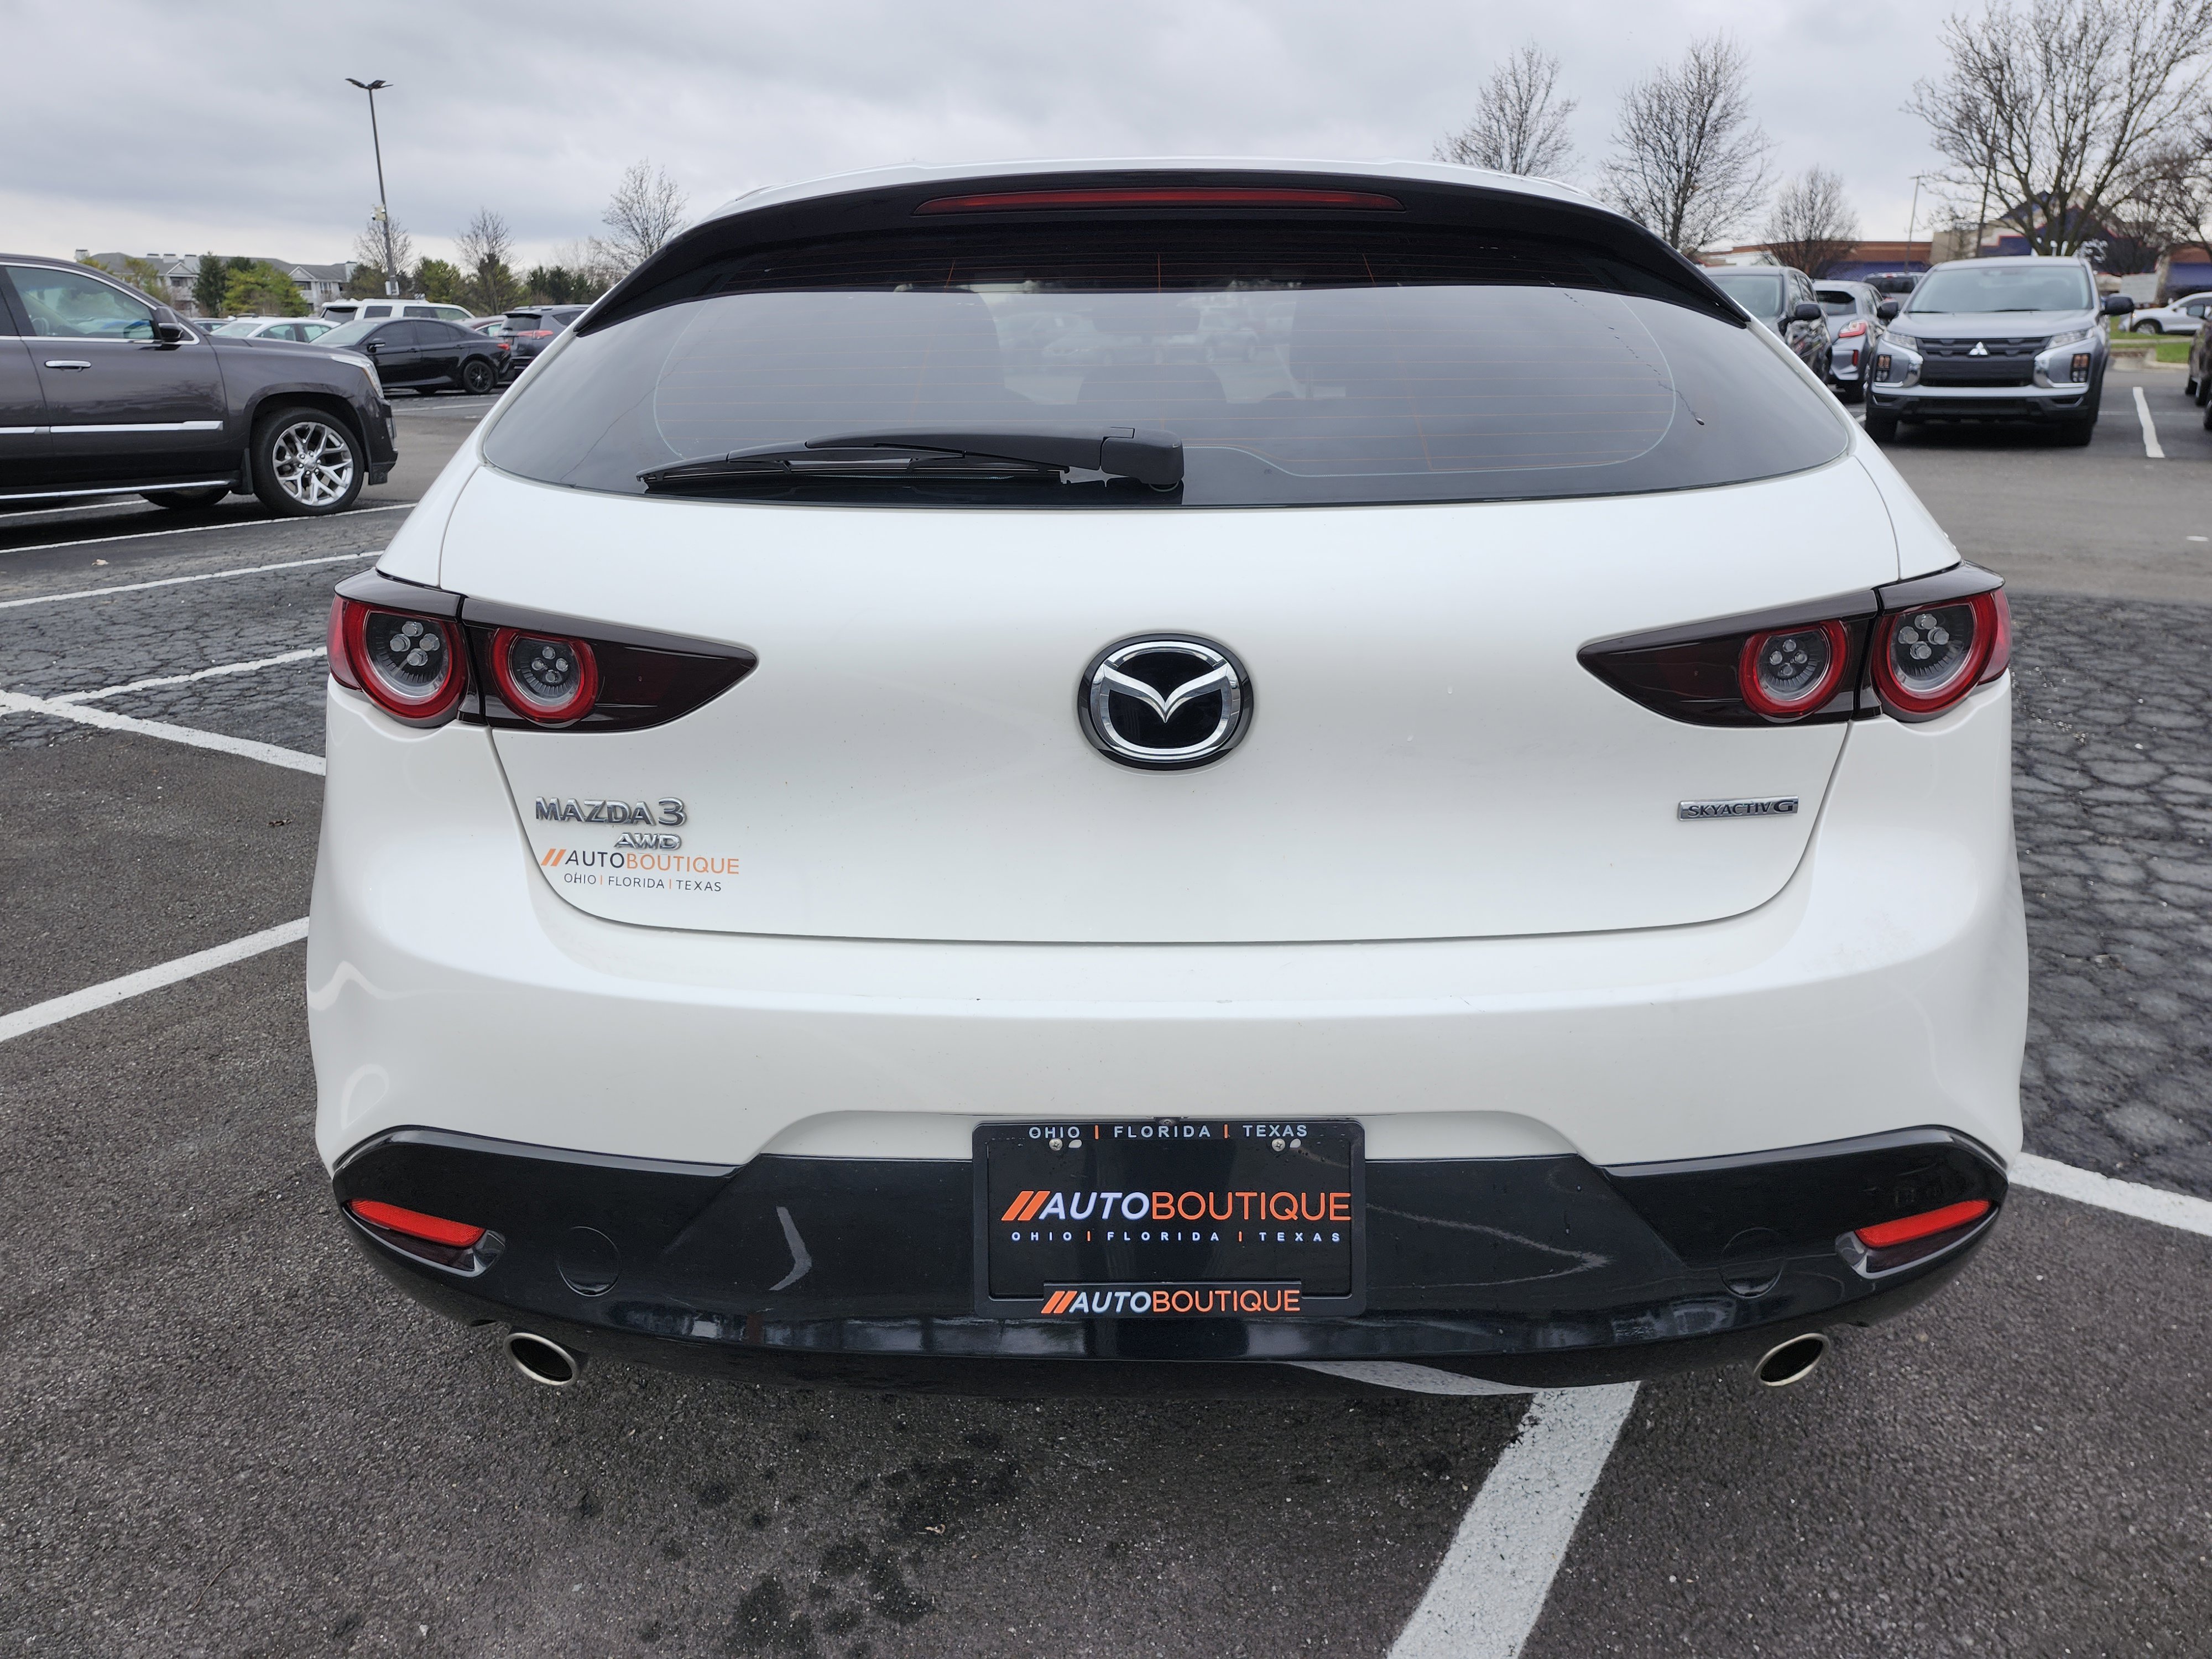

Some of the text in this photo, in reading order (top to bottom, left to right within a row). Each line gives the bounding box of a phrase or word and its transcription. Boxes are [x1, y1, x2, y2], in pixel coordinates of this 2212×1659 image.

[613, 832, 682, 851] AWD
[565, 850, 739, 874] AUTOBOUTIQUE
[564, 873, 722, 892] OHIO FLORIDA TEXAS
[1029, 1125, 1308, 1139] OHIO FLORIDA TEXAS
[1039, 1191, 1352, 1221] AUTOBOUTIQUE
[1011, 1231, 1340, 1243] OHIO FLORIDA TEXAS
[1069, 1290, 1301, 1314] AUTOBOUTIQUE
